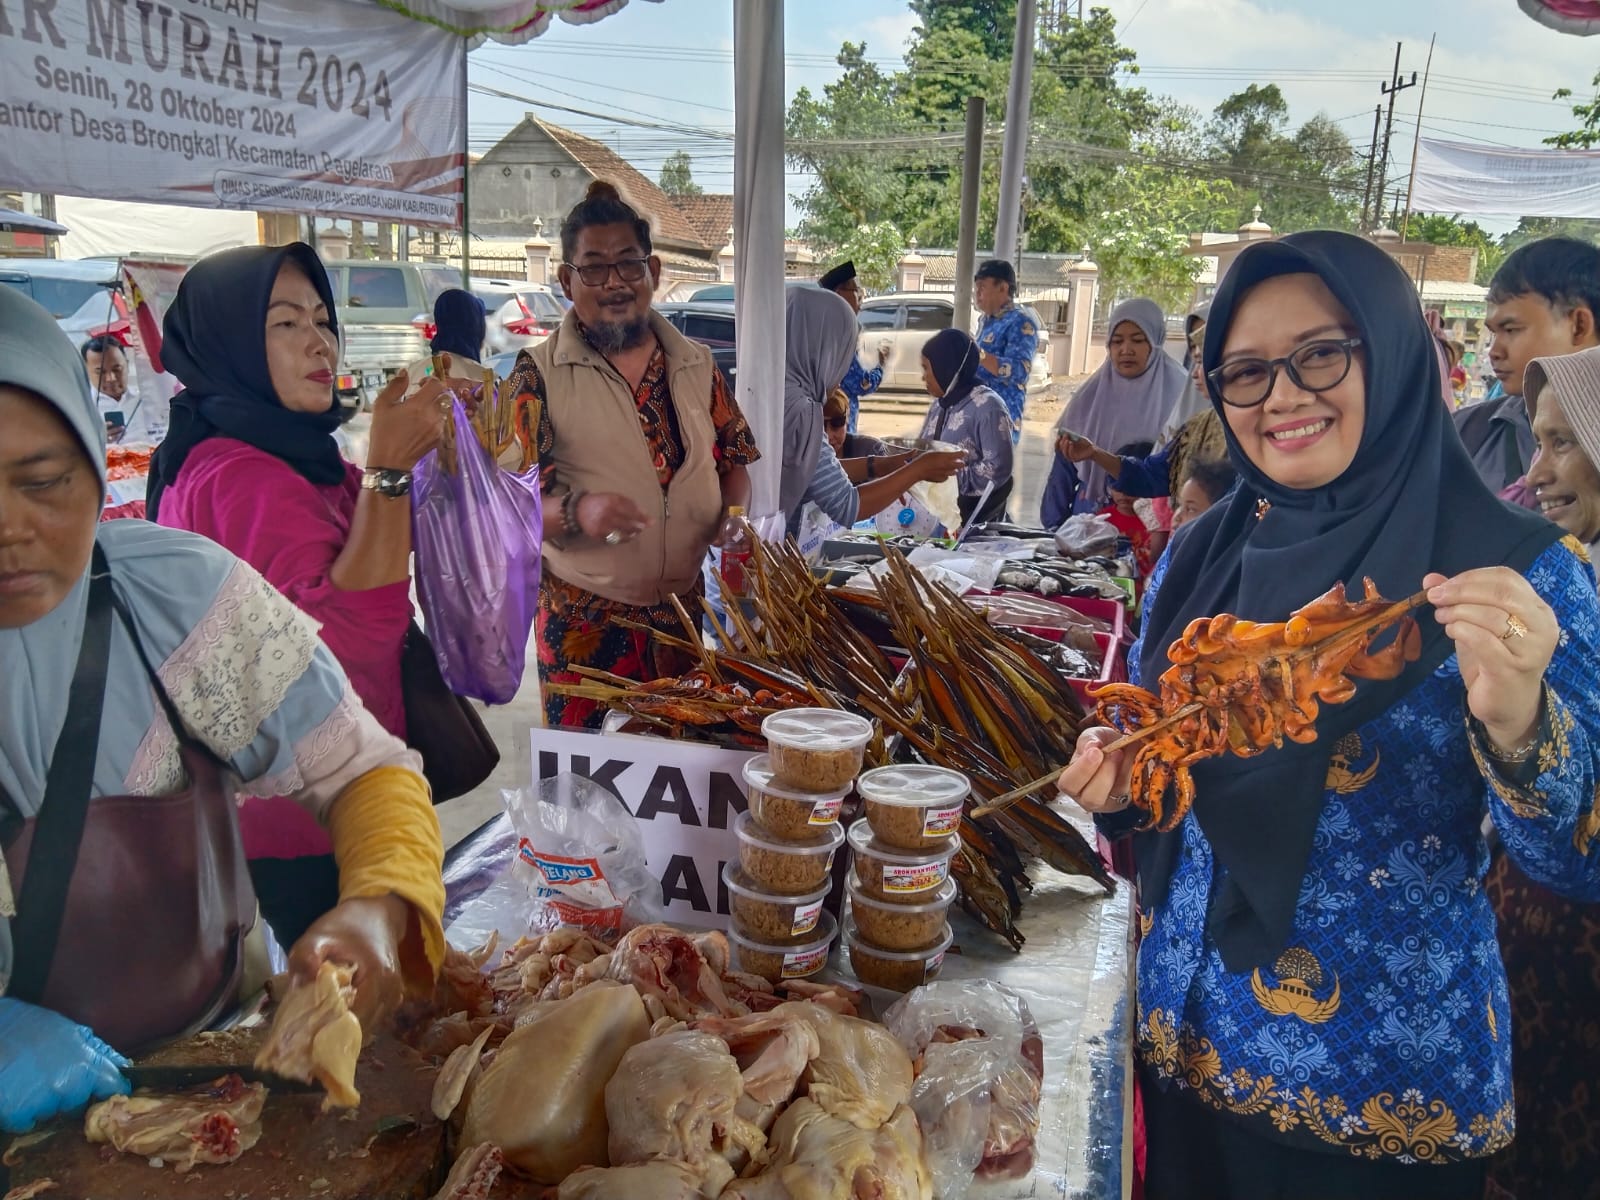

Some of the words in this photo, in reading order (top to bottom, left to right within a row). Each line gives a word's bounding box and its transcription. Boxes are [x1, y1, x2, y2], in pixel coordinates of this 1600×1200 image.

[34, 55, 118, 109] Senin,
[124, 79, 154, 113] 28
[161, 87, 245, 129] Oktober
[250, 105, 297, 138] 2024
[86, 0, 282, 99] MURAH
[297, 47, 393, 122] 2024
[70, 107, 127, 144] Desa
[132, 119, 221, 160] Brongkal
[225, 133, 319, 172] Kecamatan
[321, 151, 395, 181] Pagelaran
[221, 178, 251, 196] DINAS
[402, 199, 439, 216] KABUPATEN
